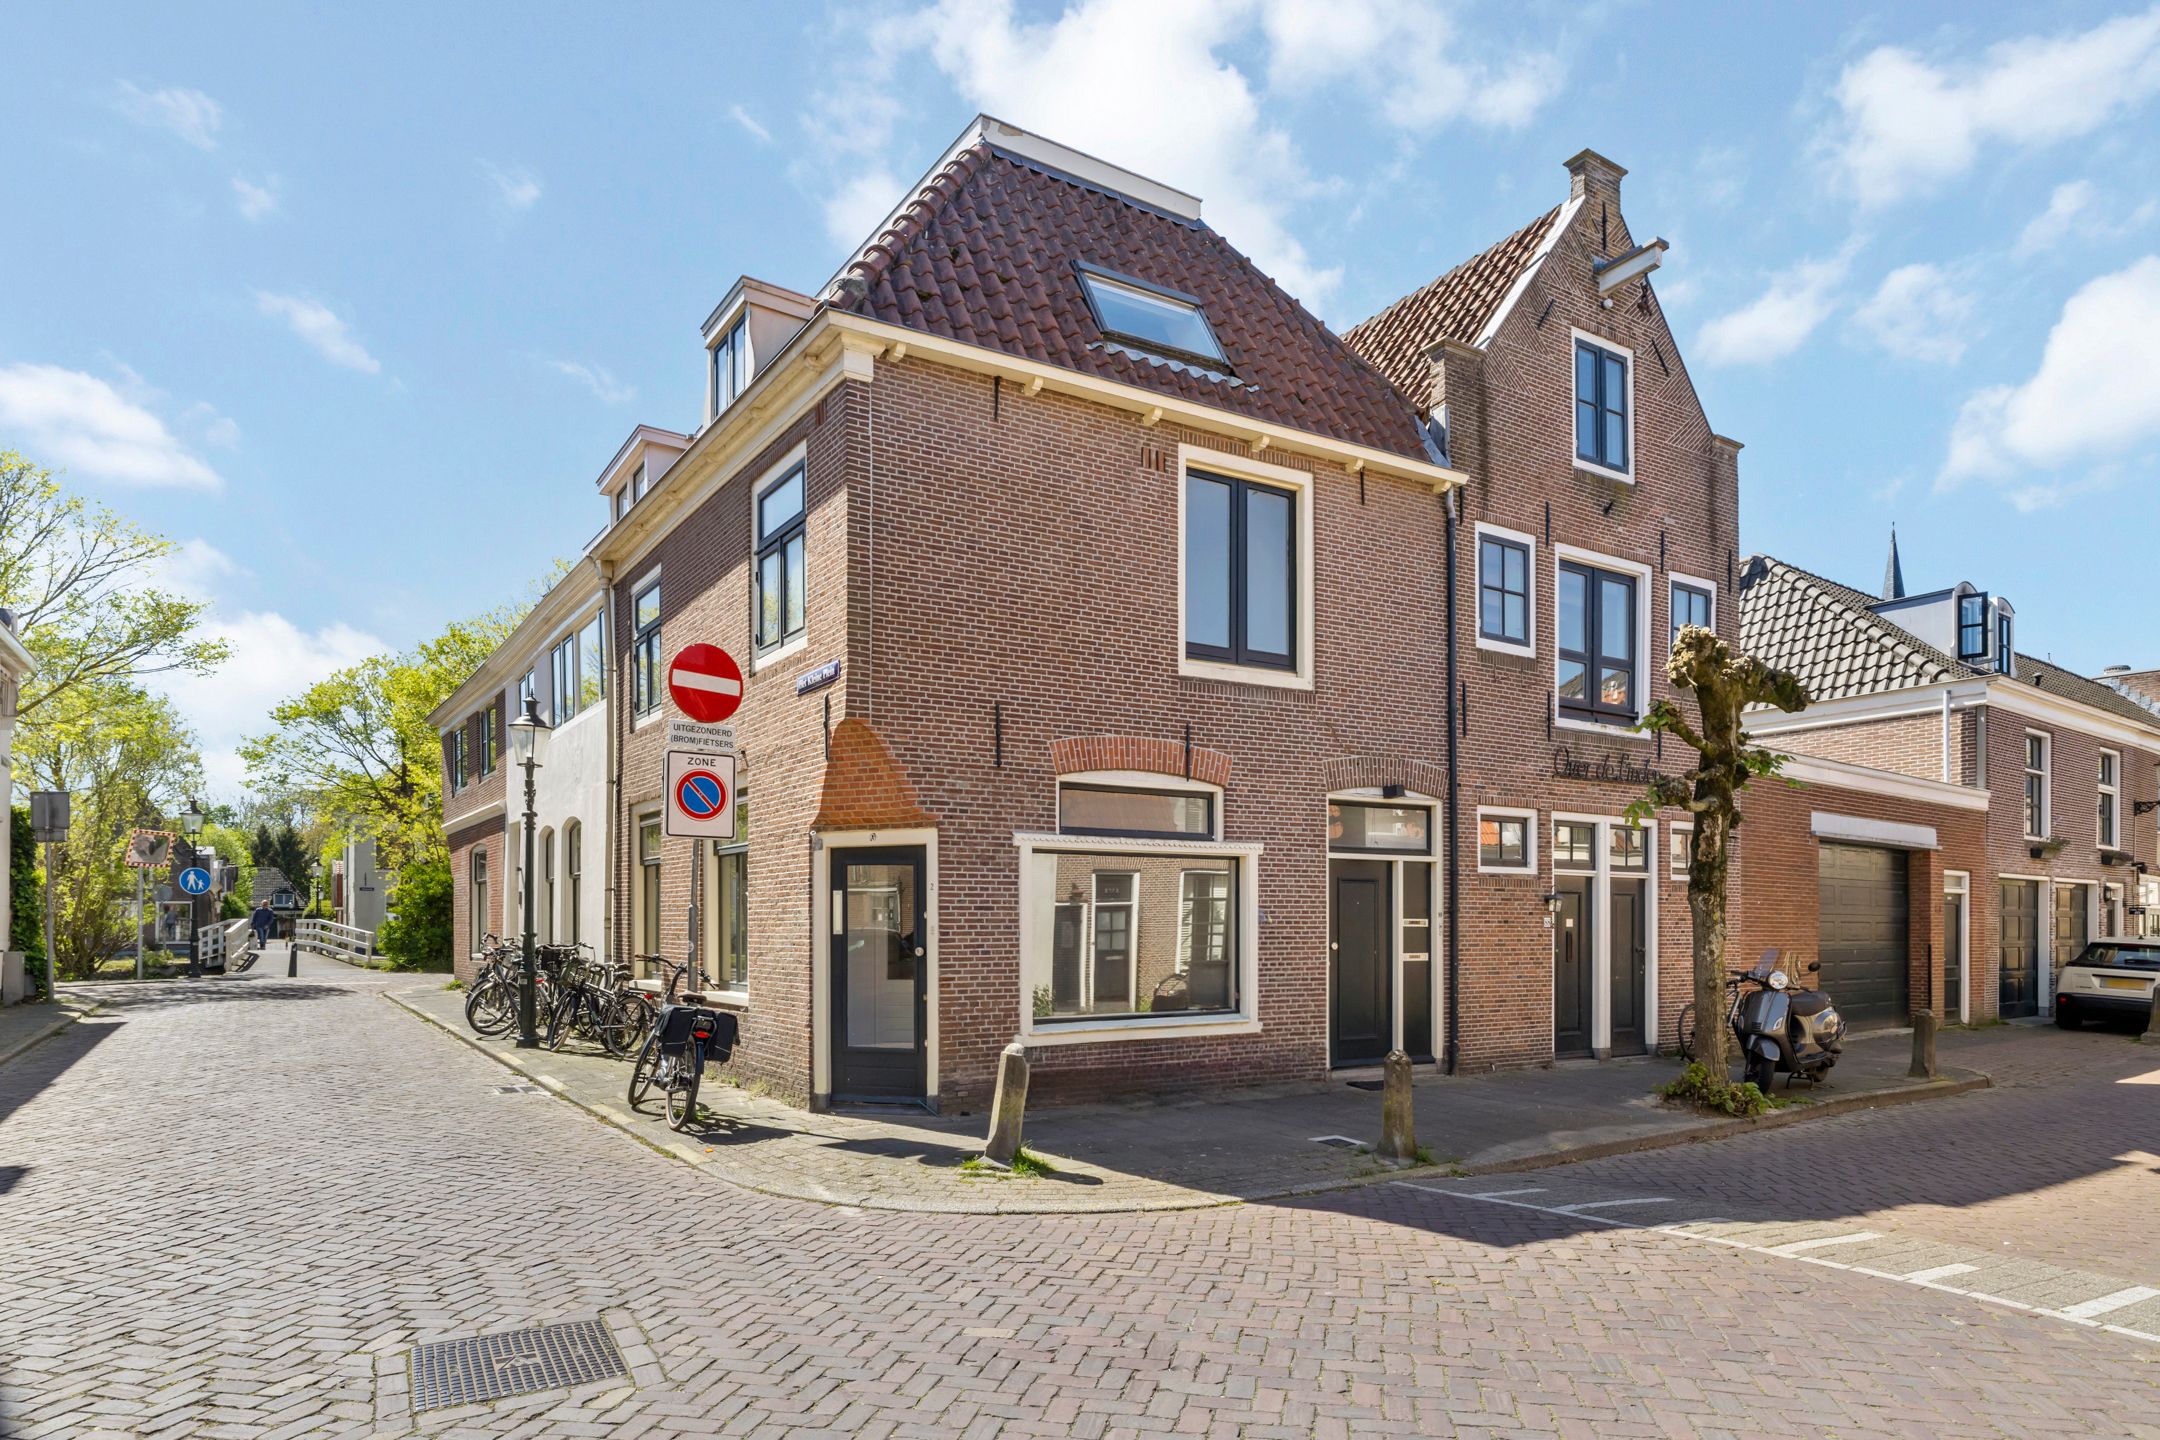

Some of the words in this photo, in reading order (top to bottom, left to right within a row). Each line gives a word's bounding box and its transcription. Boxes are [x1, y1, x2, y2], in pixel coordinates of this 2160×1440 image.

[673, 723, 733, 738] UITGEZONDERD
[670, 734, 734, 749] (BROM)FIETSERS
[687, 756, 717, 767] ZONE
[1551, 746, 1590, 779] Over
[1596, 754, 1615, 781] de
